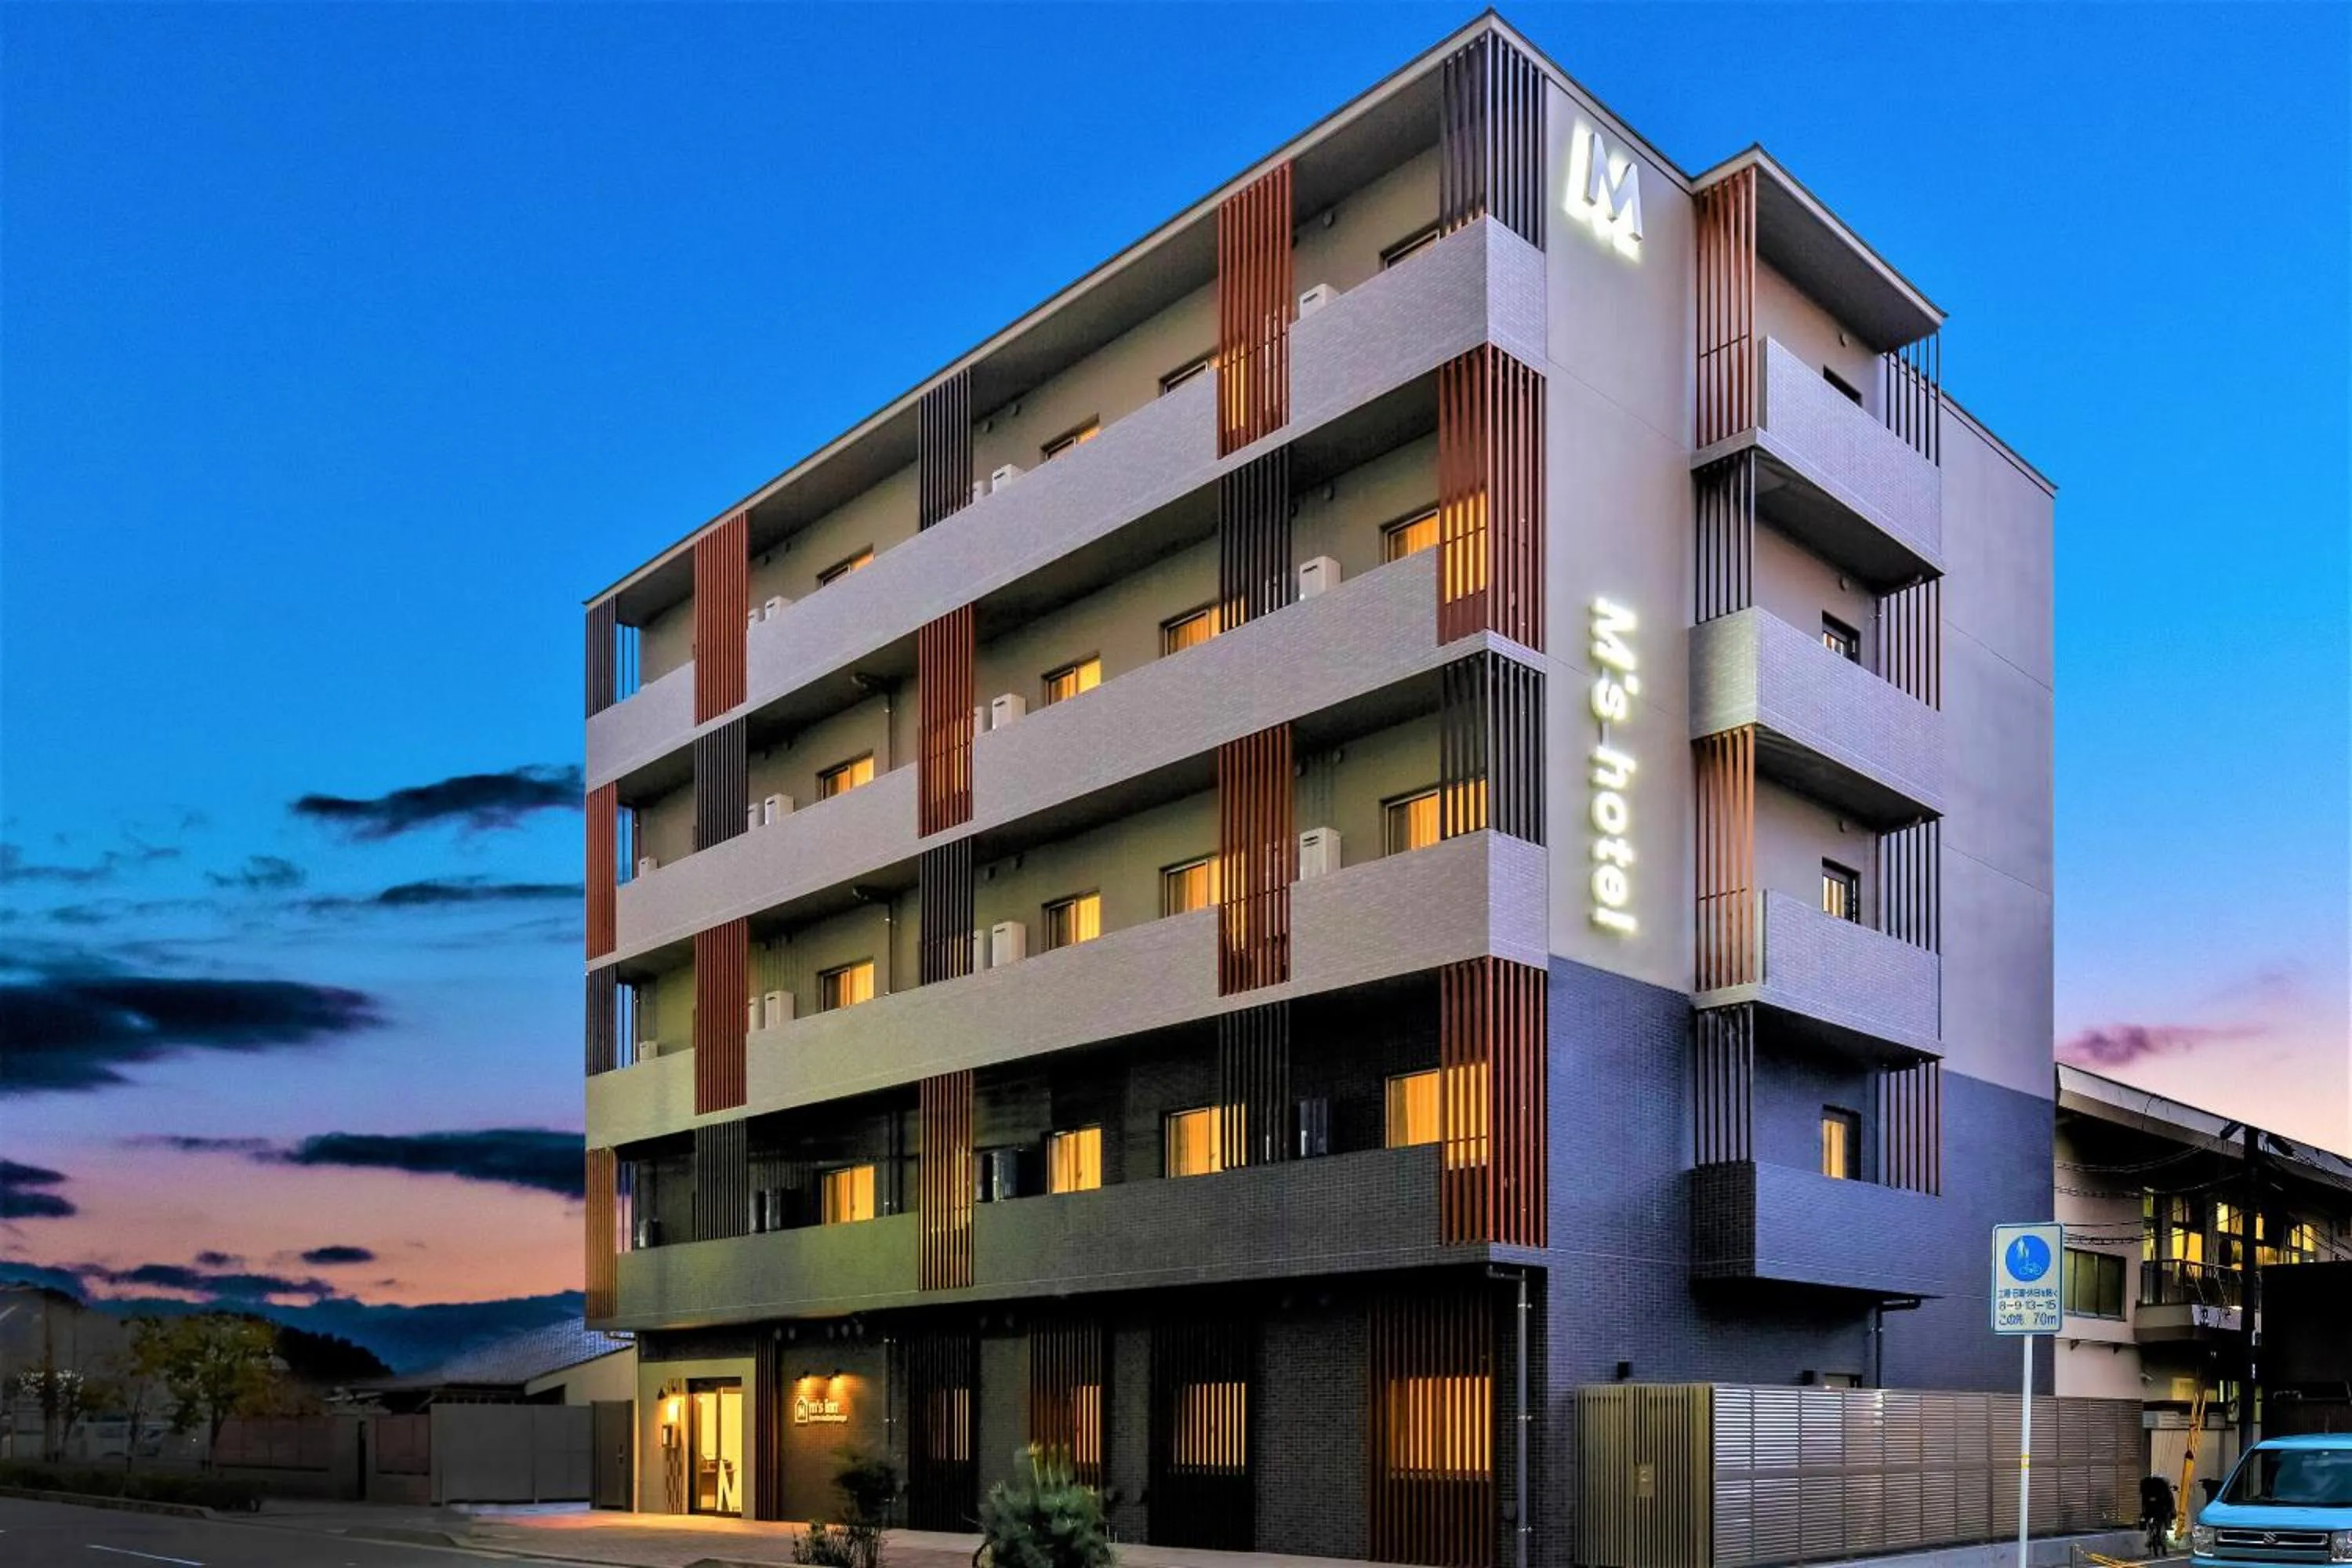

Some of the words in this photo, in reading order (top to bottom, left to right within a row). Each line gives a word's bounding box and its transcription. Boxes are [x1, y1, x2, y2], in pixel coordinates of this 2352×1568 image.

[1590, 596, 1639, 721] M's
[1590, 745, 1639, 935] hotel
[2033, 1312, 2057, 1326] 70m
